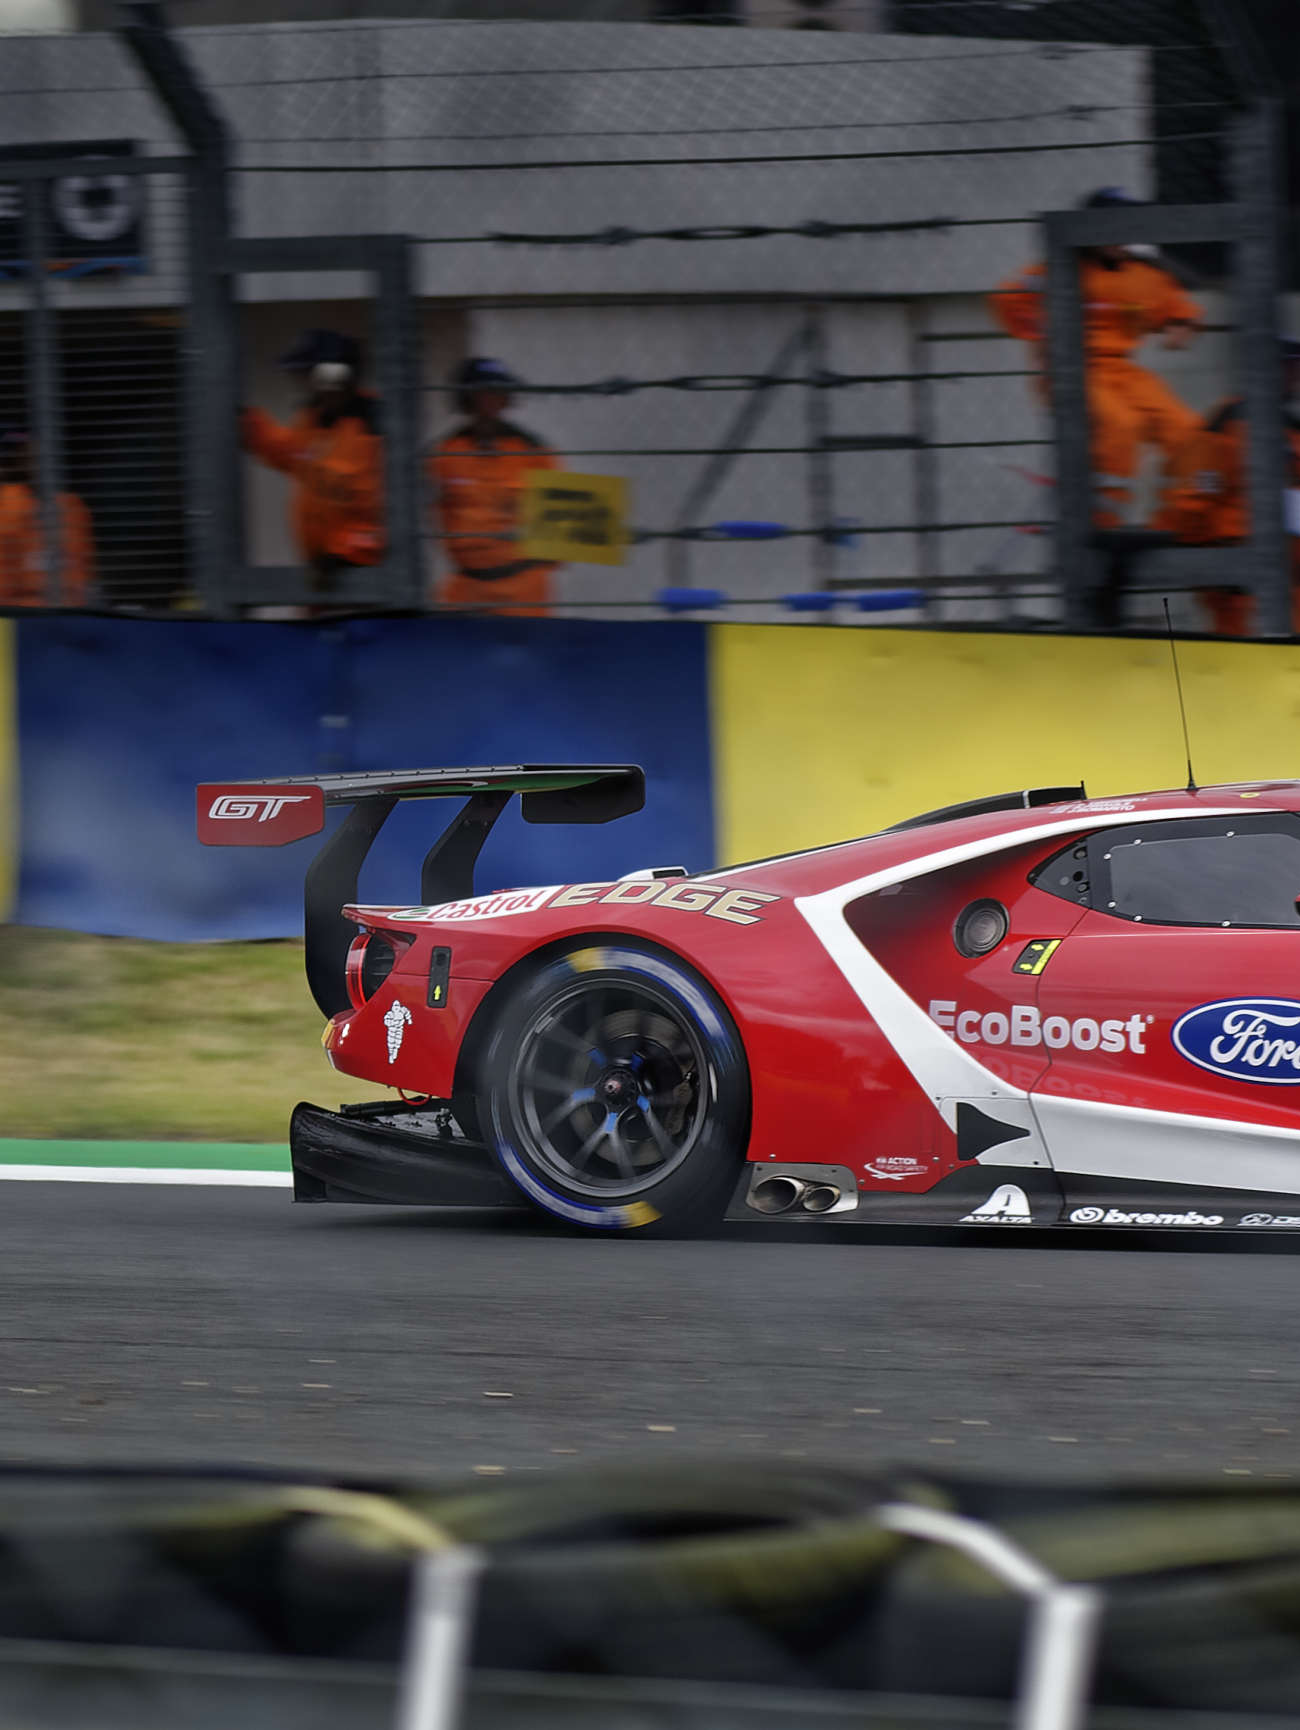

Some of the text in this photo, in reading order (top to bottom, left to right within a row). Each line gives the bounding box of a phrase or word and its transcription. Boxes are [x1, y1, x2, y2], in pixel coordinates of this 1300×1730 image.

[208, 795, 313, 823] GT
[431, 881, 782, 926] Castrol EDGE
[959, 1215, 1034, 1225] AXALTA
[1102, 1209, 1225, 1226] brembo
